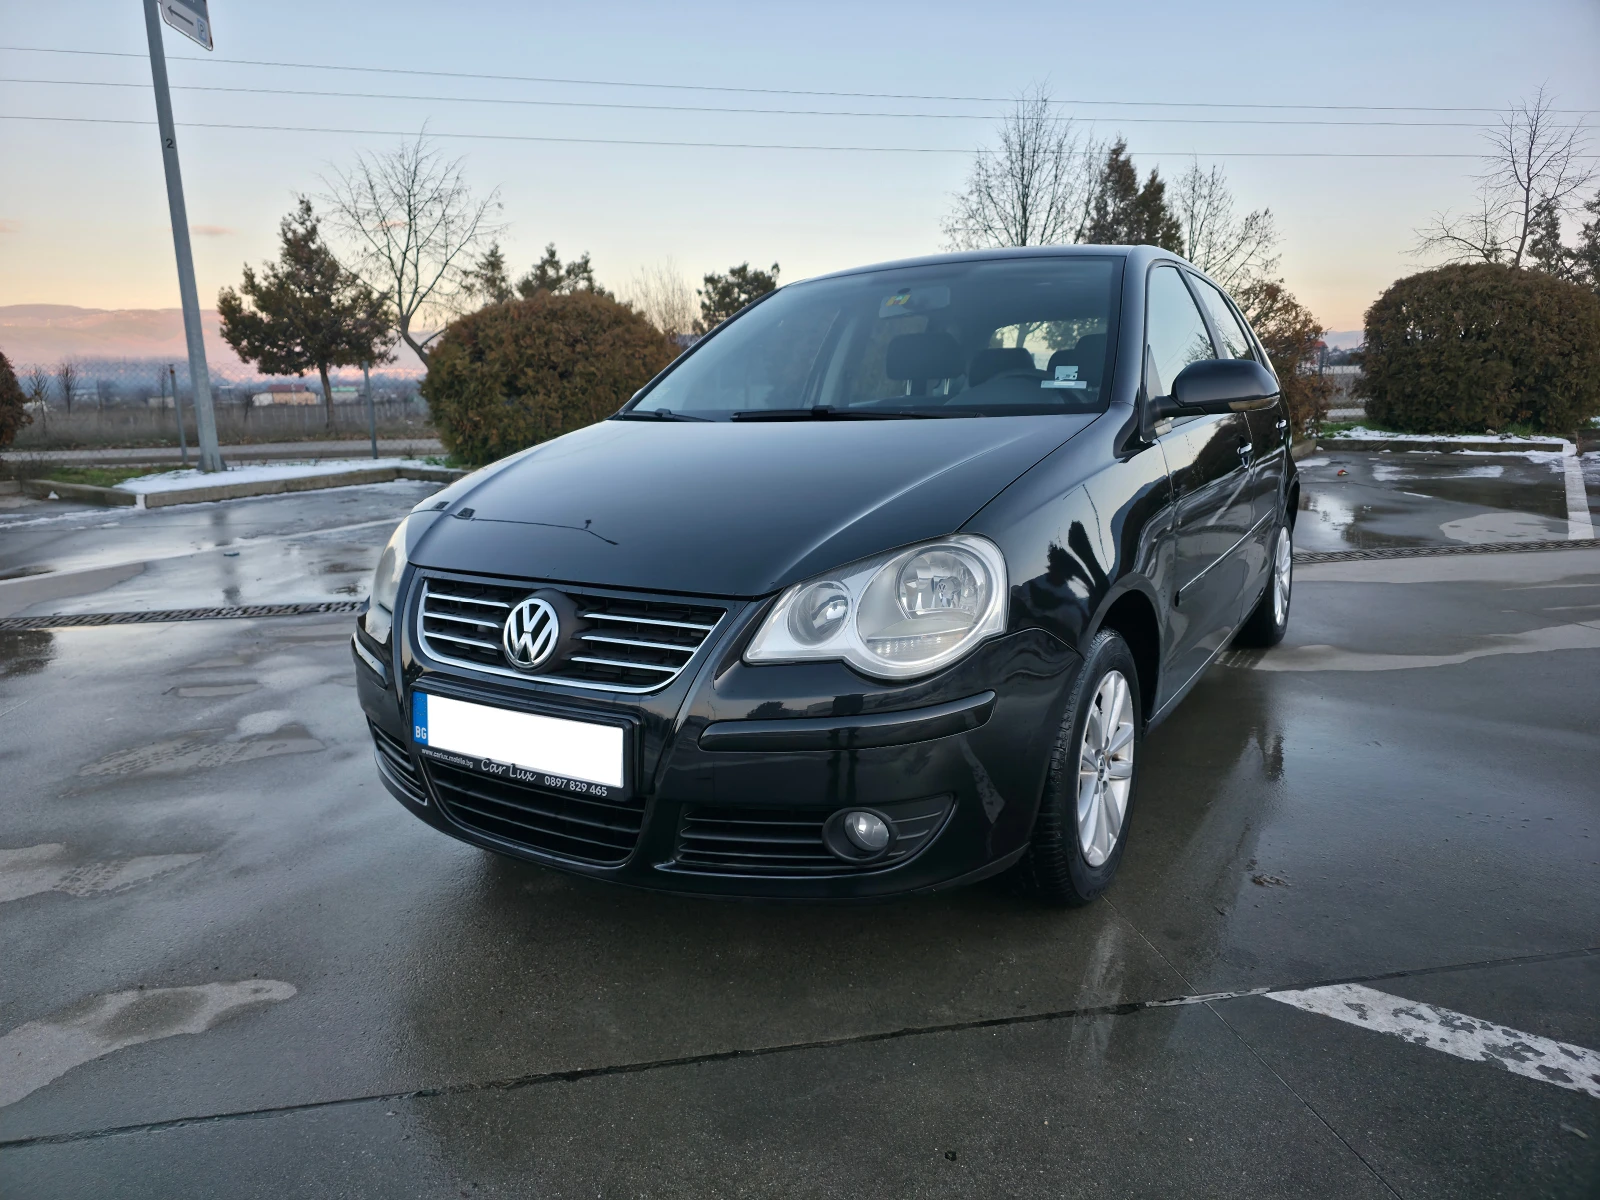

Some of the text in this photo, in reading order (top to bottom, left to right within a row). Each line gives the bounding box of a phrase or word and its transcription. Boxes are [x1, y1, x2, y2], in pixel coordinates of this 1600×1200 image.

[165, 138, 174, 149] 2
[415, 725, 427, 740] BG
[480, 758, 537, 783] Car Lux
[544, 775, 608, 797] 0897 829 465
